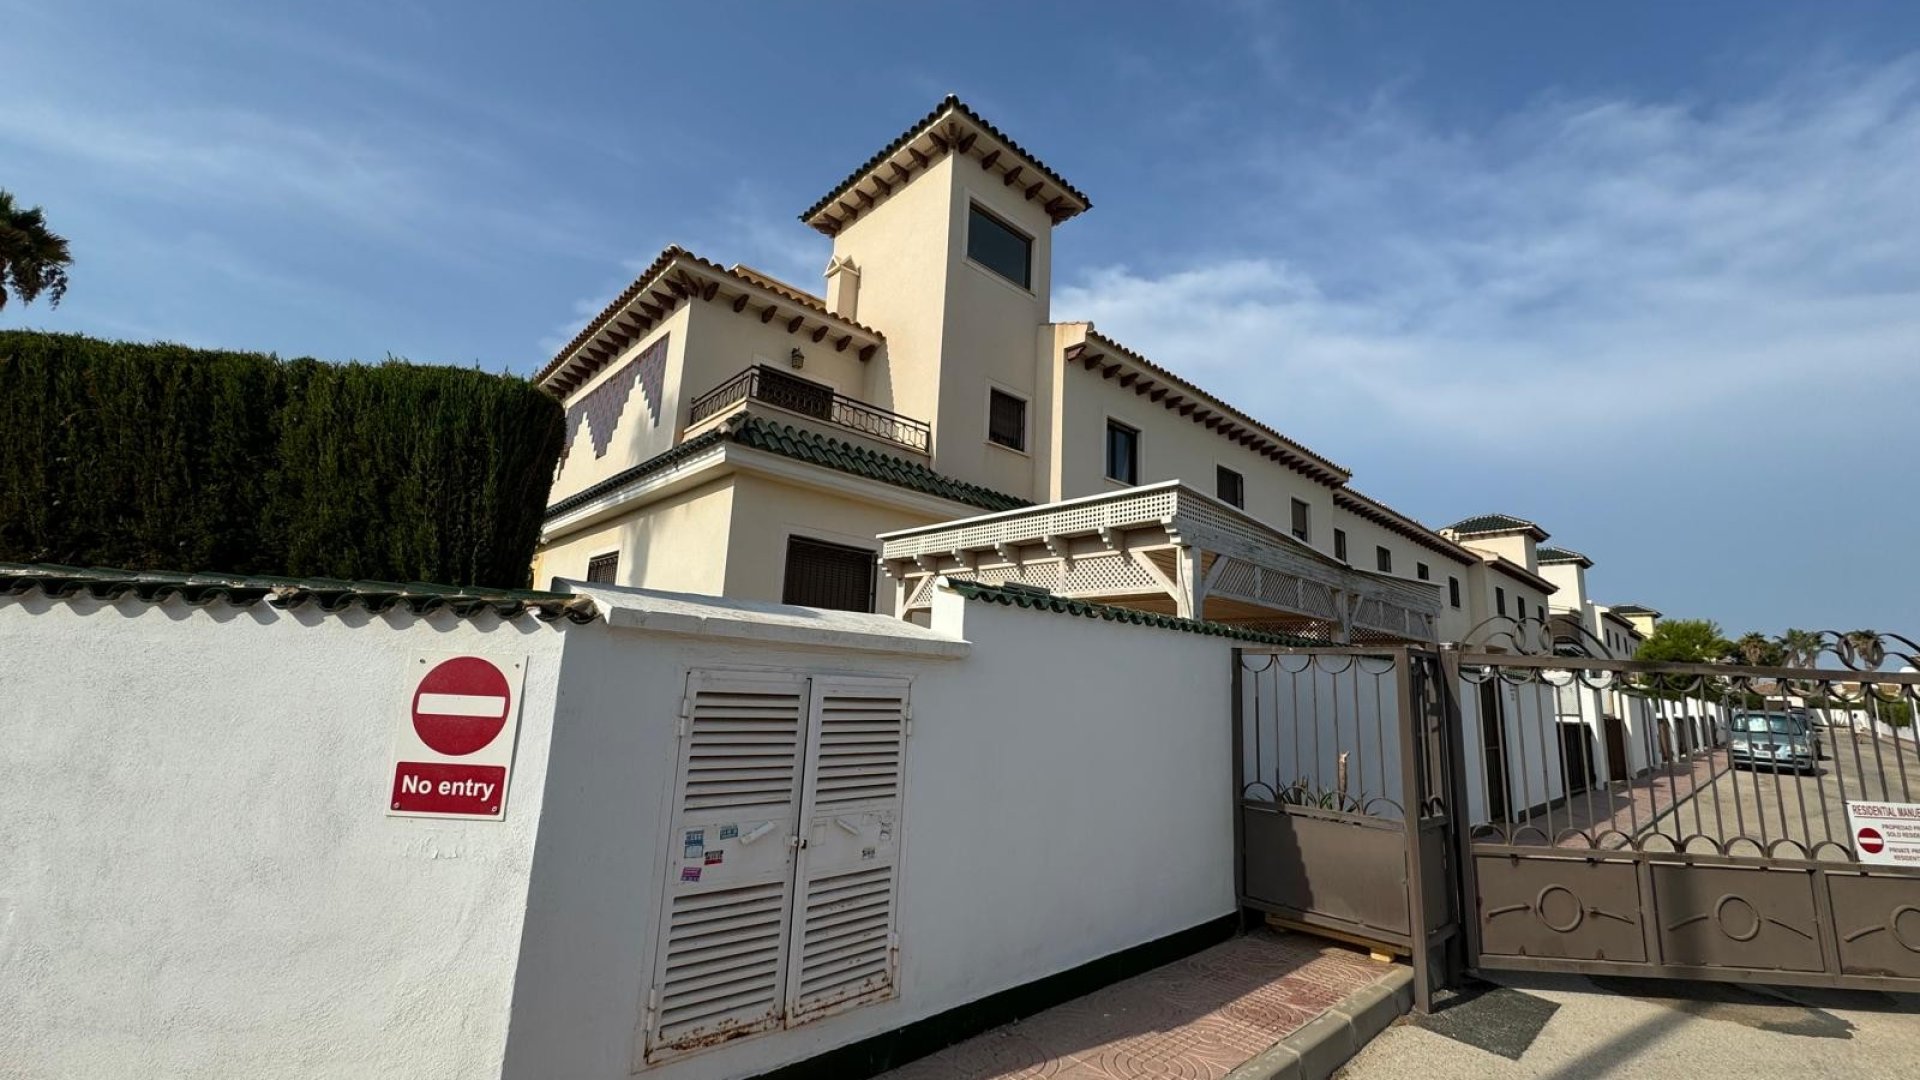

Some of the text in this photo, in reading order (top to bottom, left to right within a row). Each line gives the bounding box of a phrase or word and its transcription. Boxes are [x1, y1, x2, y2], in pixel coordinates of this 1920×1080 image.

[401, 774, 495, 802] No entry
[1852, 805, 1897, 817] RESIDENTIAL
